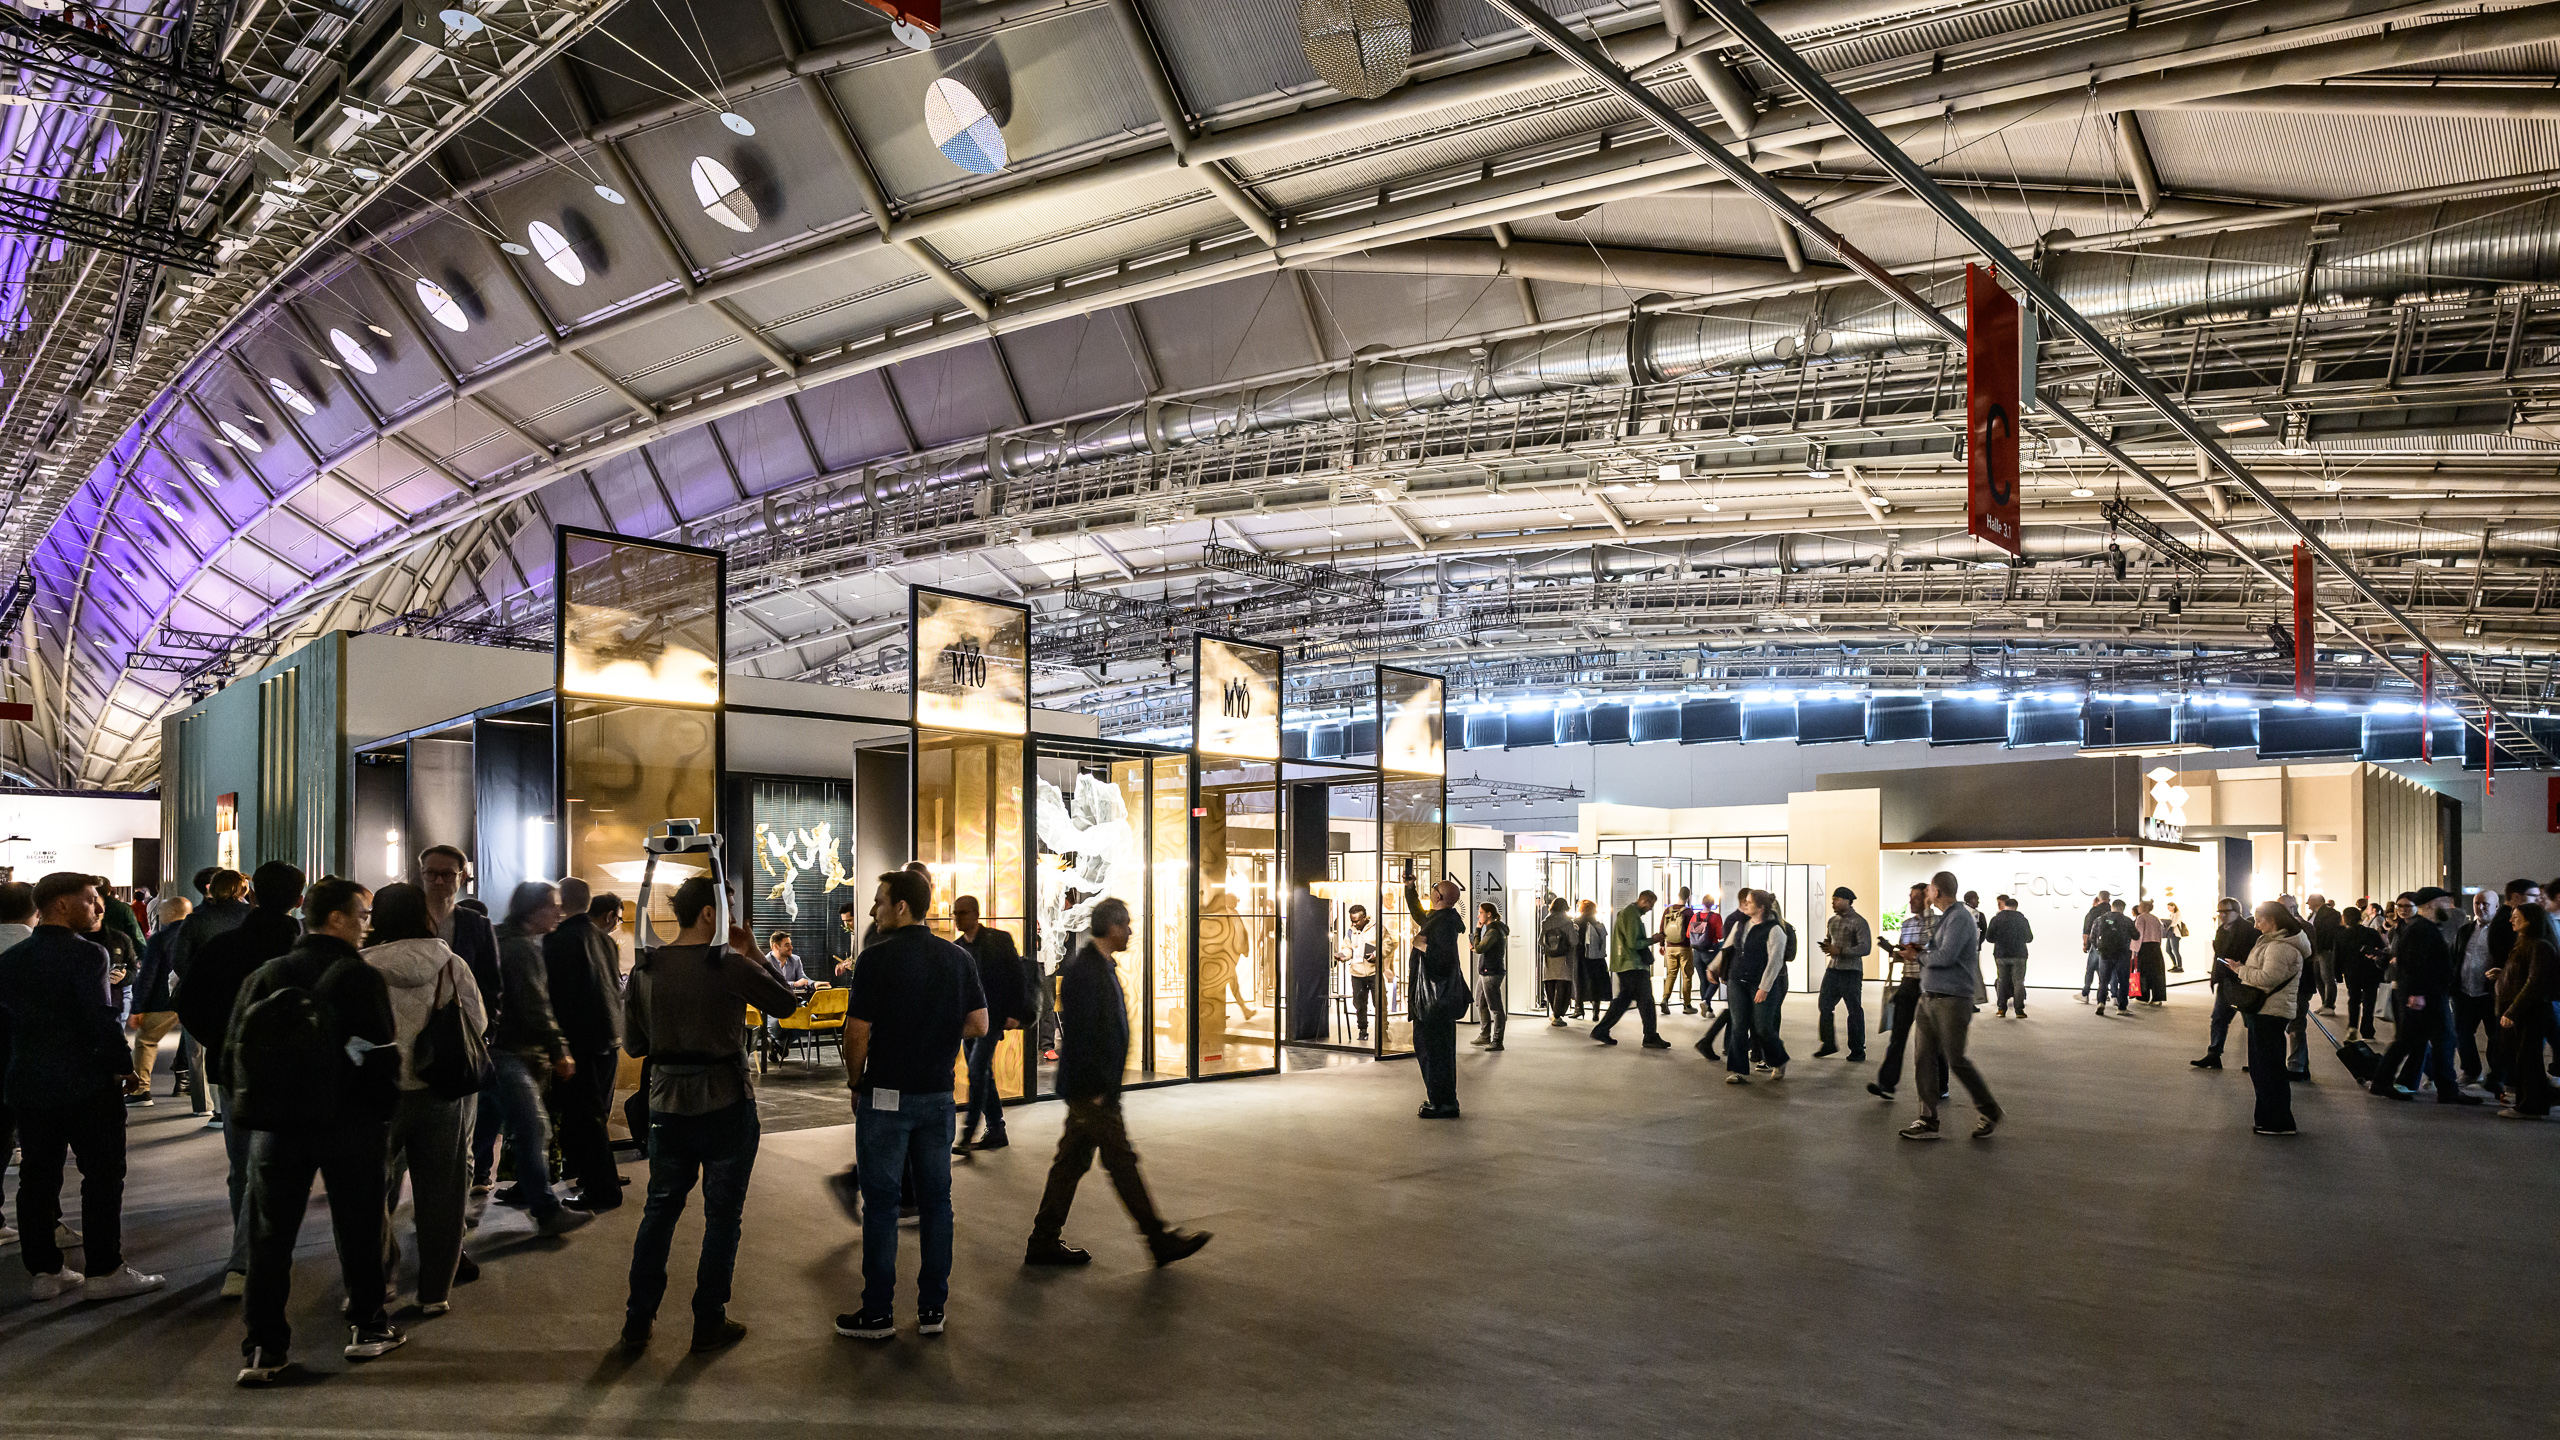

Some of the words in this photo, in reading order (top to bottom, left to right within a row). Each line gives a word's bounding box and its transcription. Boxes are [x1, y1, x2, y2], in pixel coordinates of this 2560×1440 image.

[1986, 403, 2011, 506] C
[1986, 513, 2003, 535] Halle
[2003, 523, 2012, 540] 3.1
[951, 644, 986, 688] MYO
[1224, 682, 1250, 719] MYO
